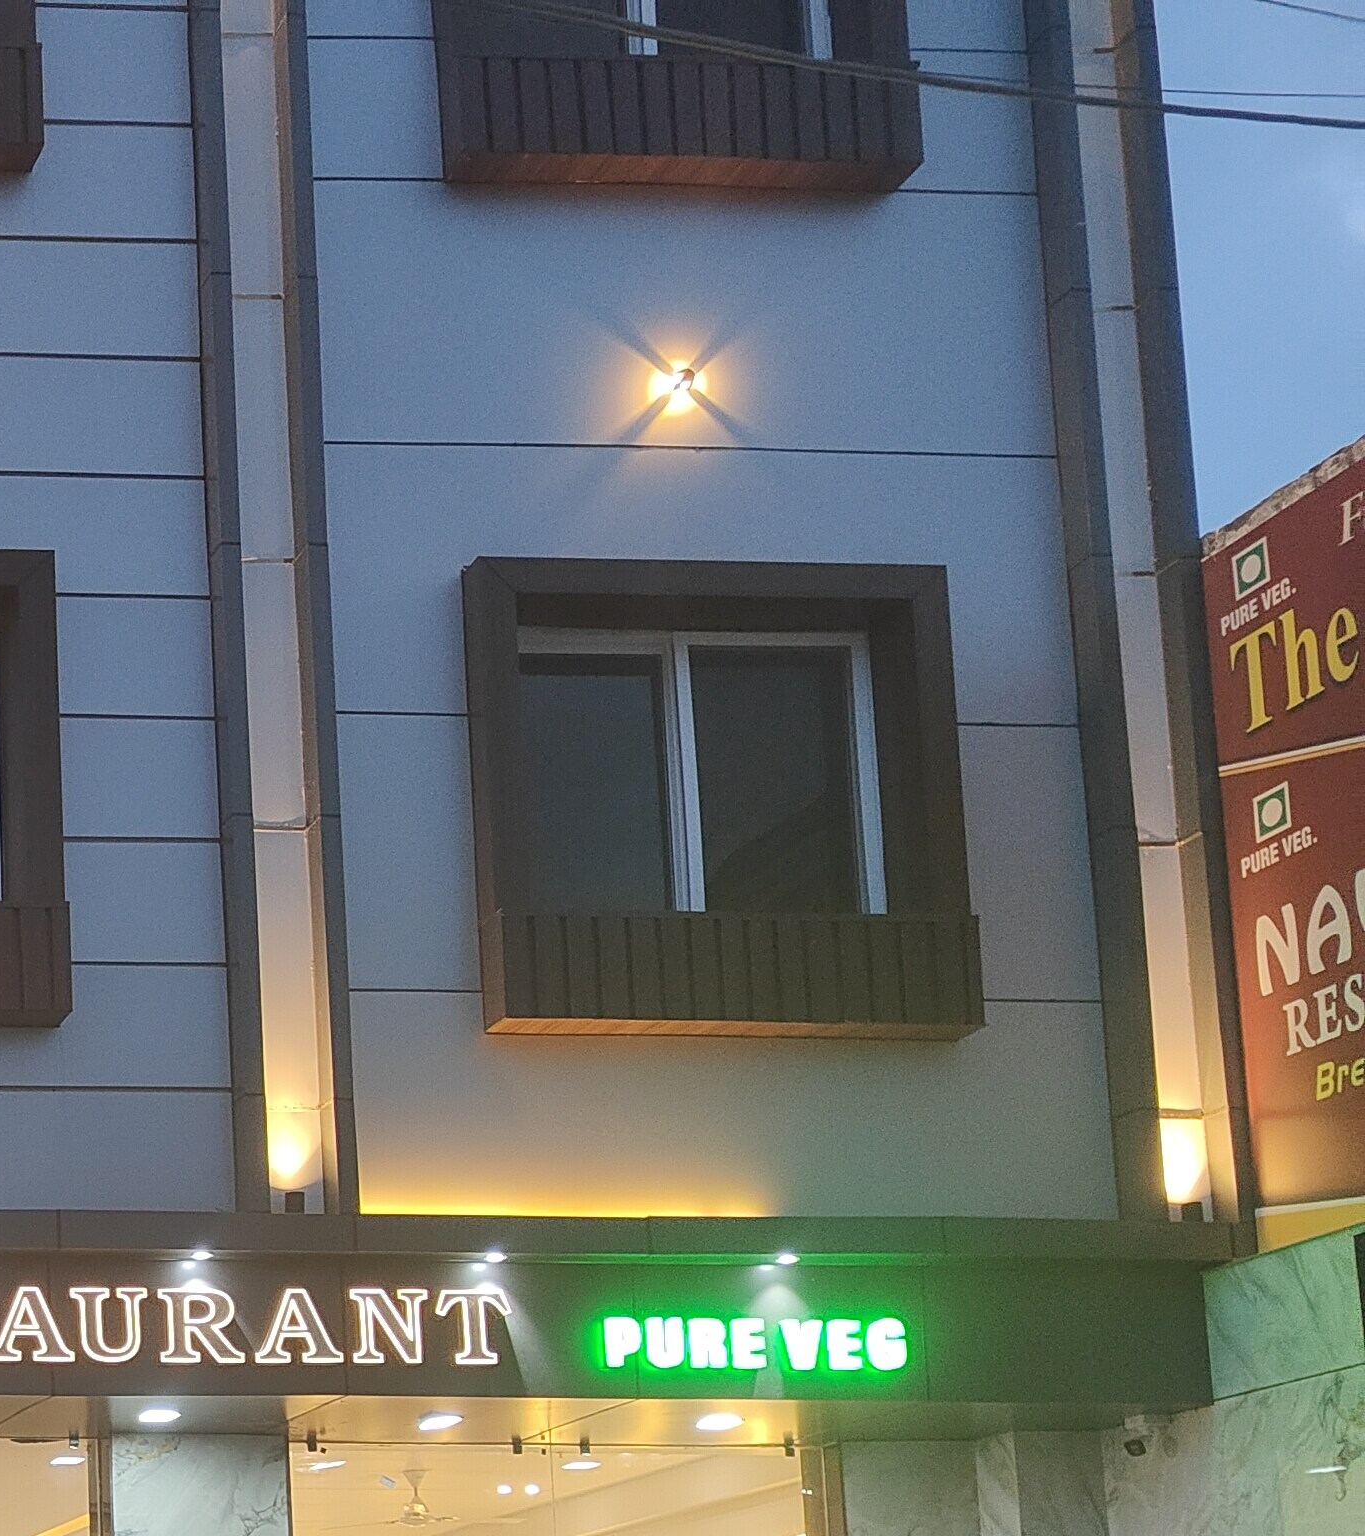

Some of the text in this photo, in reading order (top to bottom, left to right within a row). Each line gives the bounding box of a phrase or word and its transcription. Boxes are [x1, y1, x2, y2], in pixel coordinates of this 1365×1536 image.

[1220, 577, 1297, 637] PURE VEG.
[1230, 607, 1359, 733] The
[1240, 825, 1318, 878] PURE VEG.
[1283, 973, 1365, 1056] RES
[1316, 1058, 1365, 1101] Bre
[601, 1315, 908, 1371] PURE VEG
